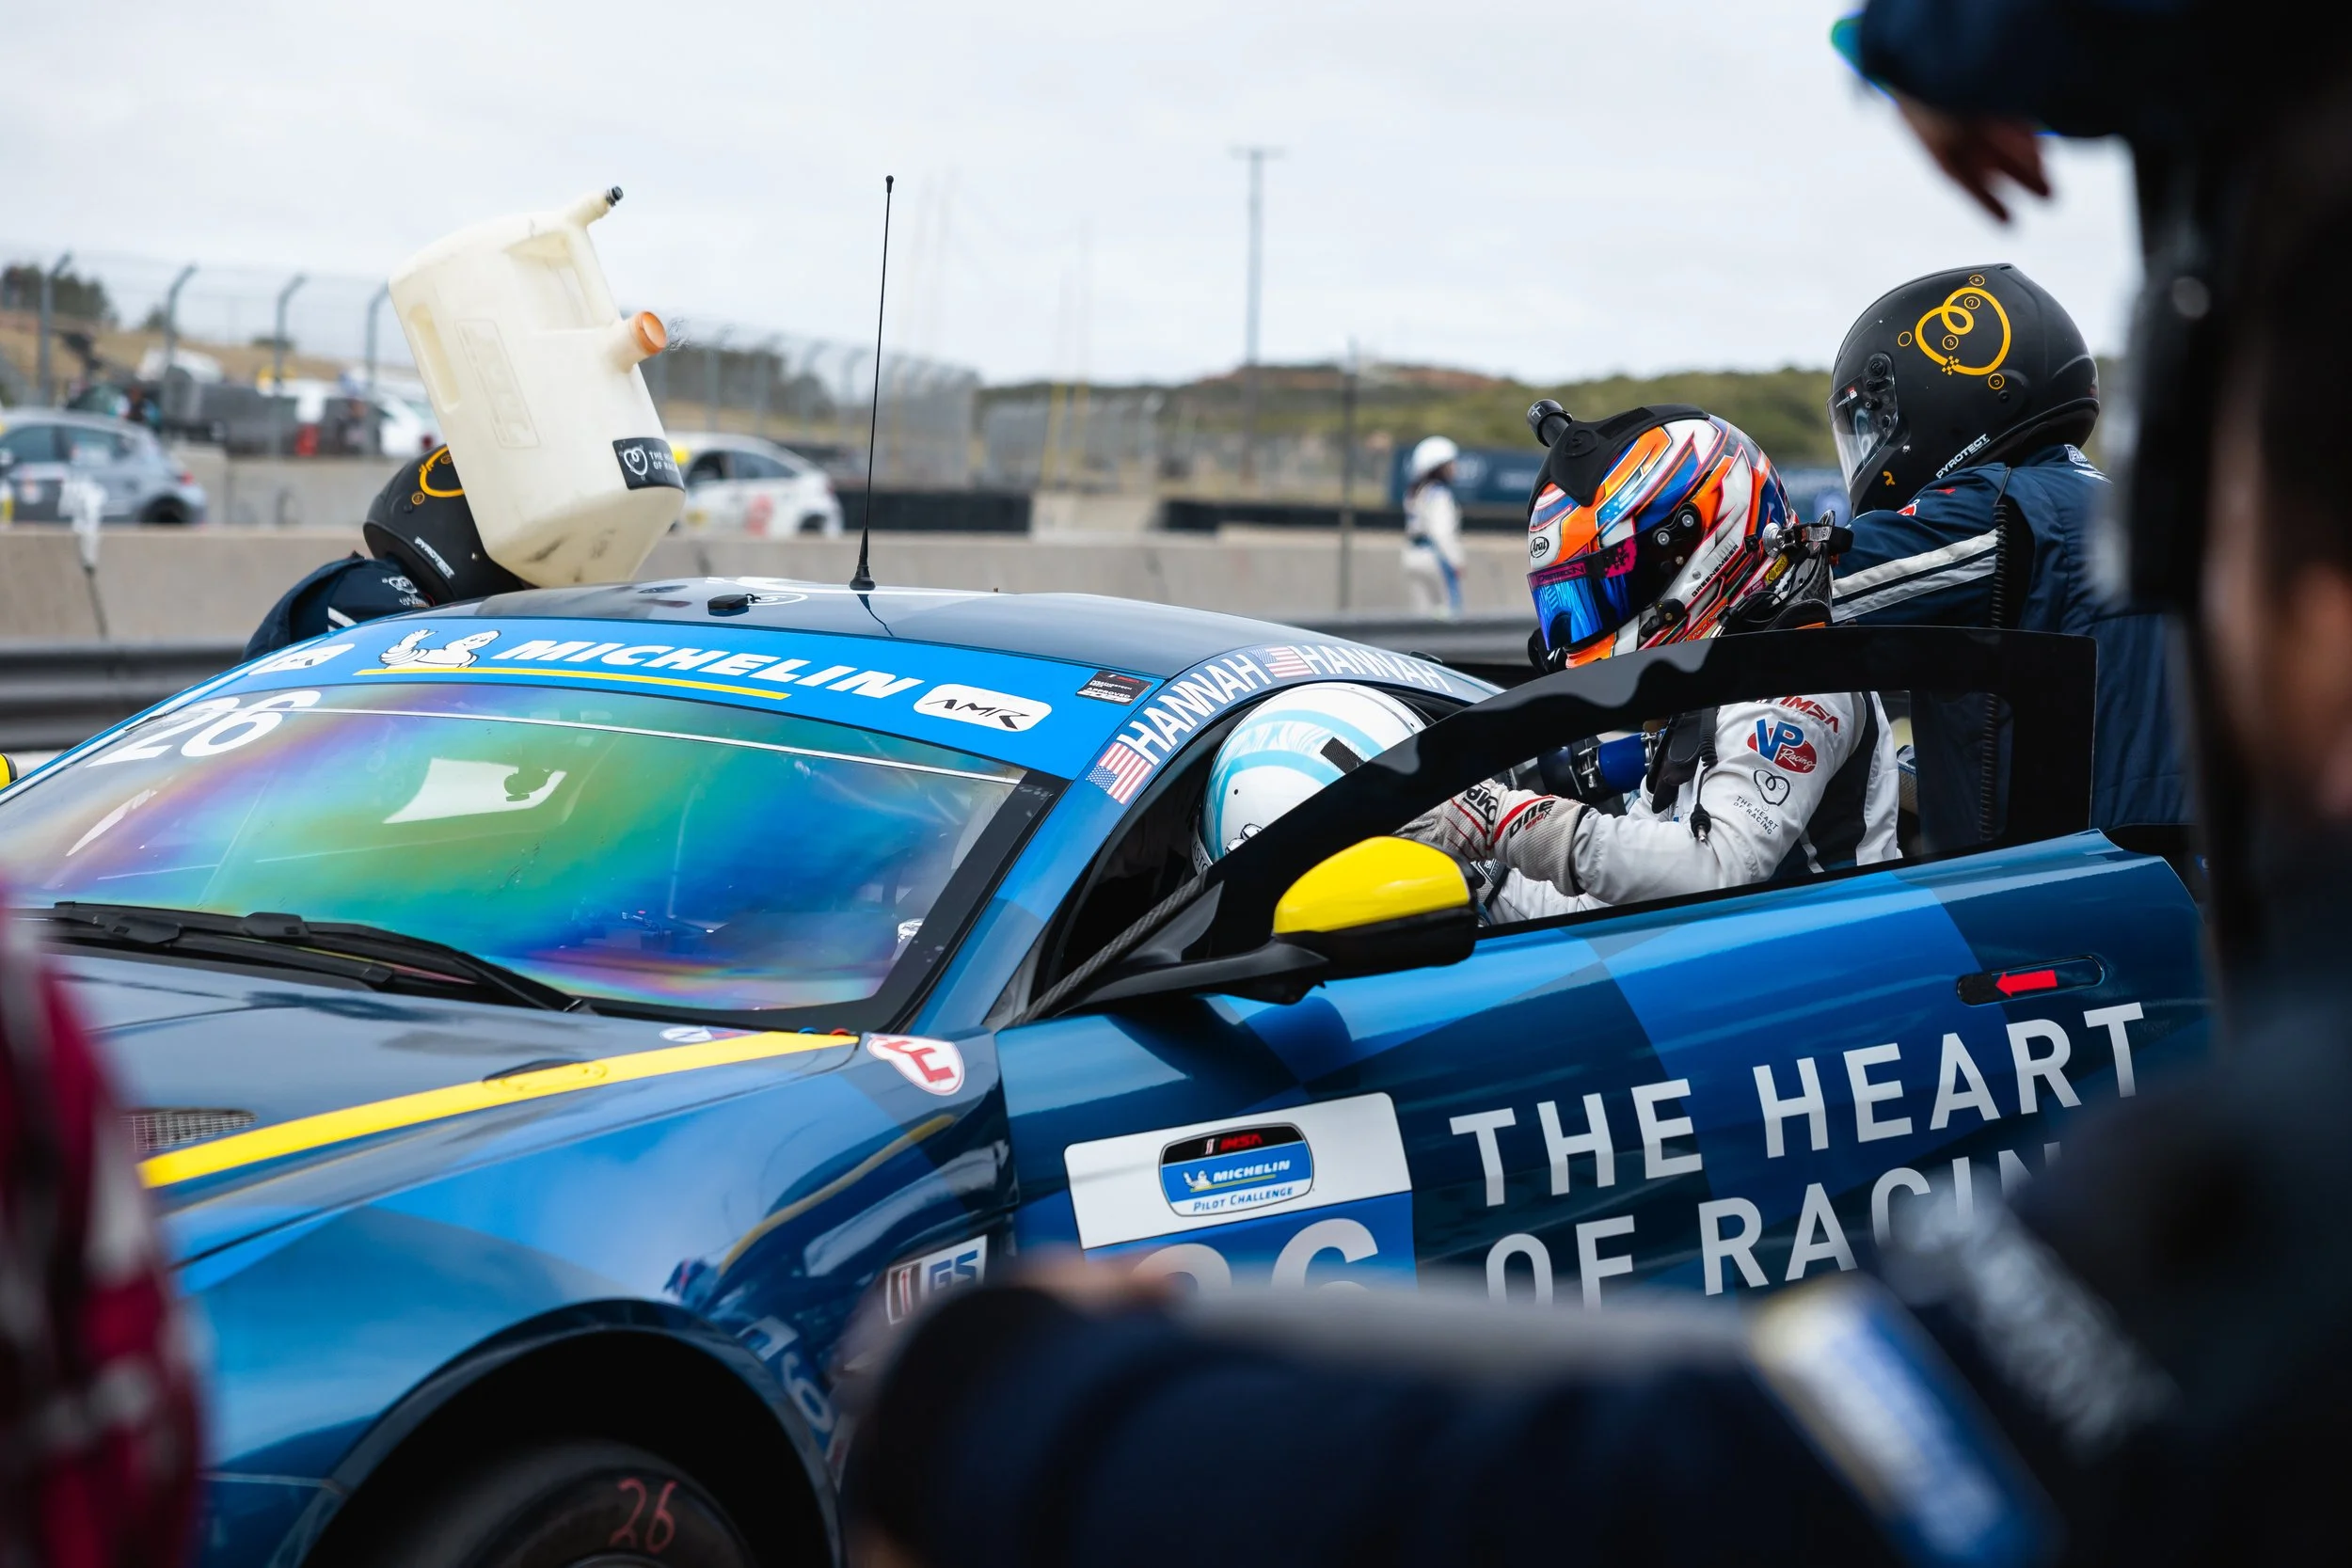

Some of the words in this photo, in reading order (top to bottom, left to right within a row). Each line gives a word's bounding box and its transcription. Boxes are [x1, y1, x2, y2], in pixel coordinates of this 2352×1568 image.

[1936, 434, 1986, 479] PYROTECT
[415, 536, 454, 578] PYROTECT
[1532, 538, 1547, 554] Arai
[490, 640, 926, 699] MICHELIN
[1286, 644, 1454, 694] HANNAH
[1086, 687, 1131, 699] APPROVED
[1117, 653, 1273, 767] HANNAH
[85, 690, 322, 768] 26
[925, 699, 1030, 730] AMR
[1780, 695, 1839, 734] IMSA
[1756, 718, 1805, 762] VP
[1778, 748, 1817, 770] Racing
[1736, 796, 1753, 809] THE
[1754, 807, 1779, 830] HEART
[1746, 807, 1772, 835] RACING
[1450, 1079, 1703, 1208] THE
[1753, 1002, 2145, 1158] HEART
[1219, 1132, 1263, 1150] IMSA
[1213, 1160, 1292, 1183] MICHELIN
[929, 1249, 979, 1291] GS
[1486, 1214, 1636, 1311] OF
[610, 1477, 678, 1555] 26
